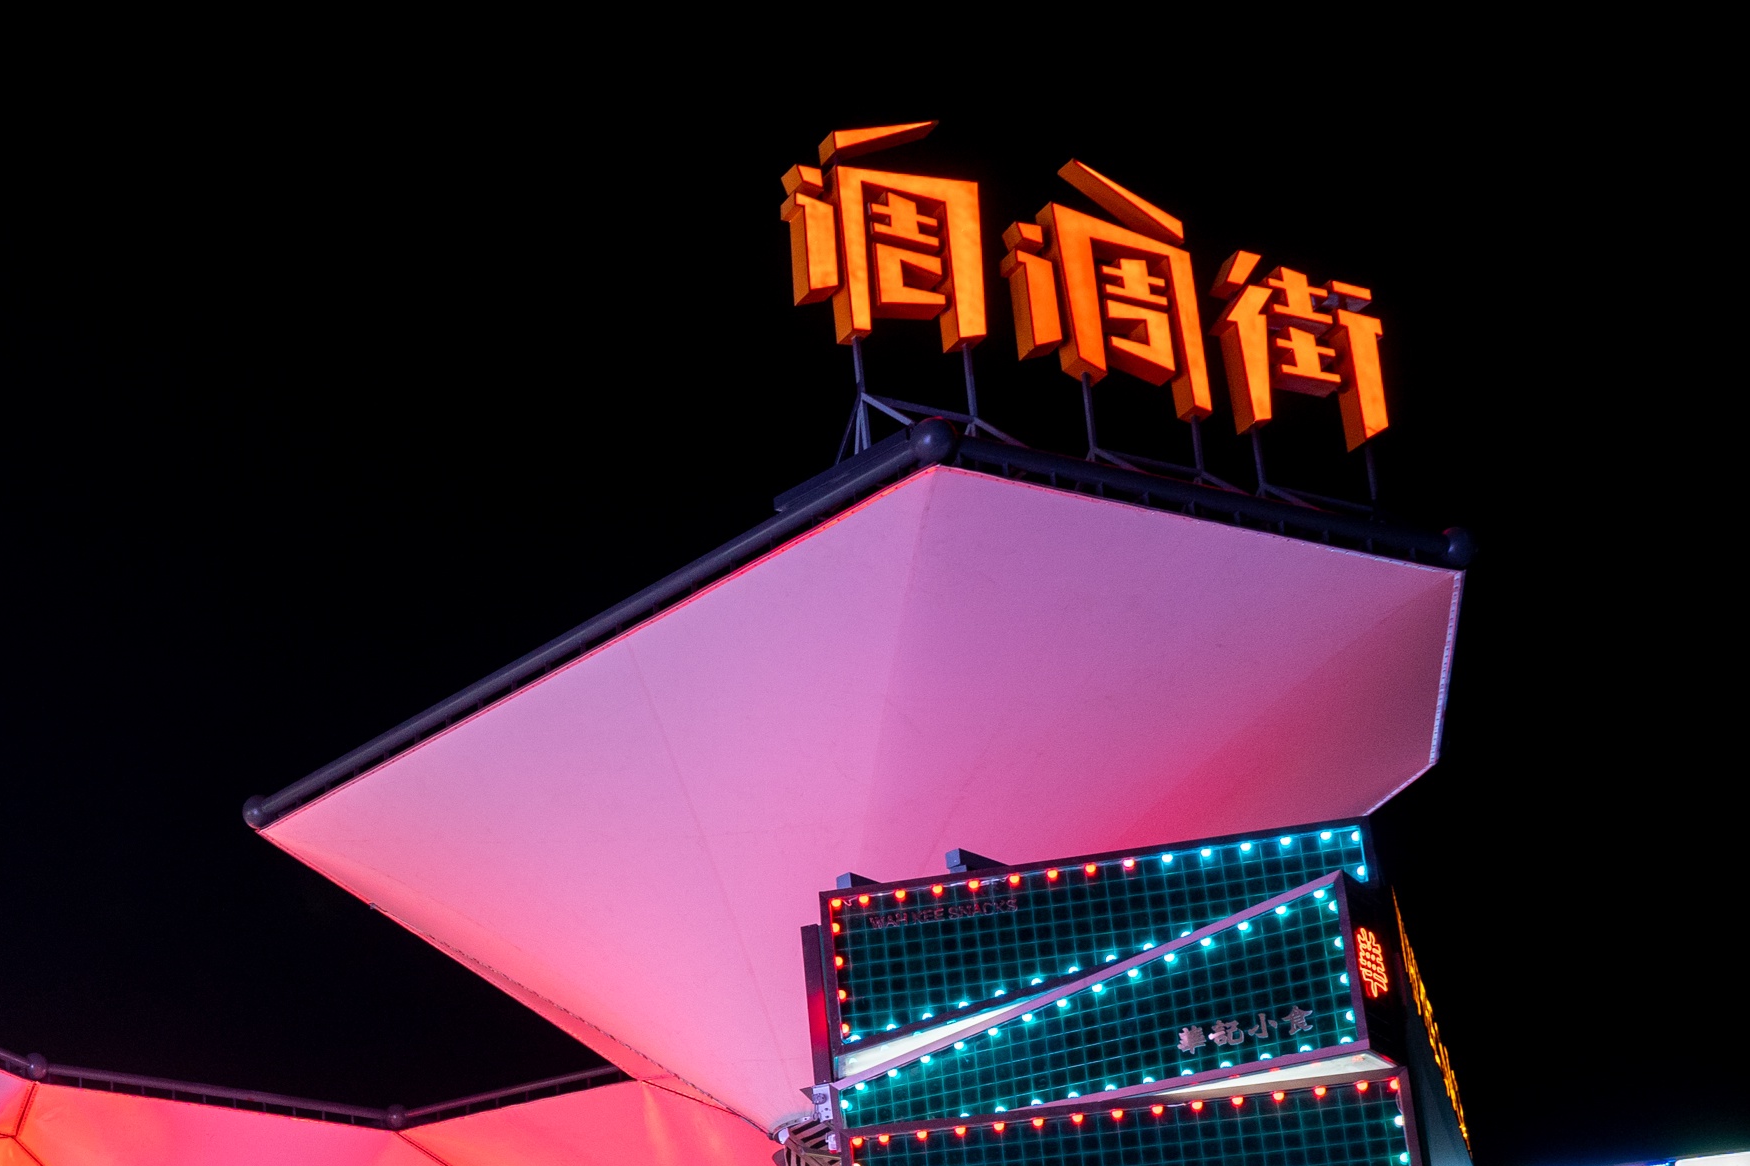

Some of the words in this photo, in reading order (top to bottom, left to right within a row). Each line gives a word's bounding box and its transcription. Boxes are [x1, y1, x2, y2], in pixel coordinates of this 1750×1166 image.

[869, 912, 908, 929] WAH
[912, 908, 945, 924] KEE
[948, 899, 1018, 920] SNACKS
[1177, 1005, 1313, 1054] 華記小食
